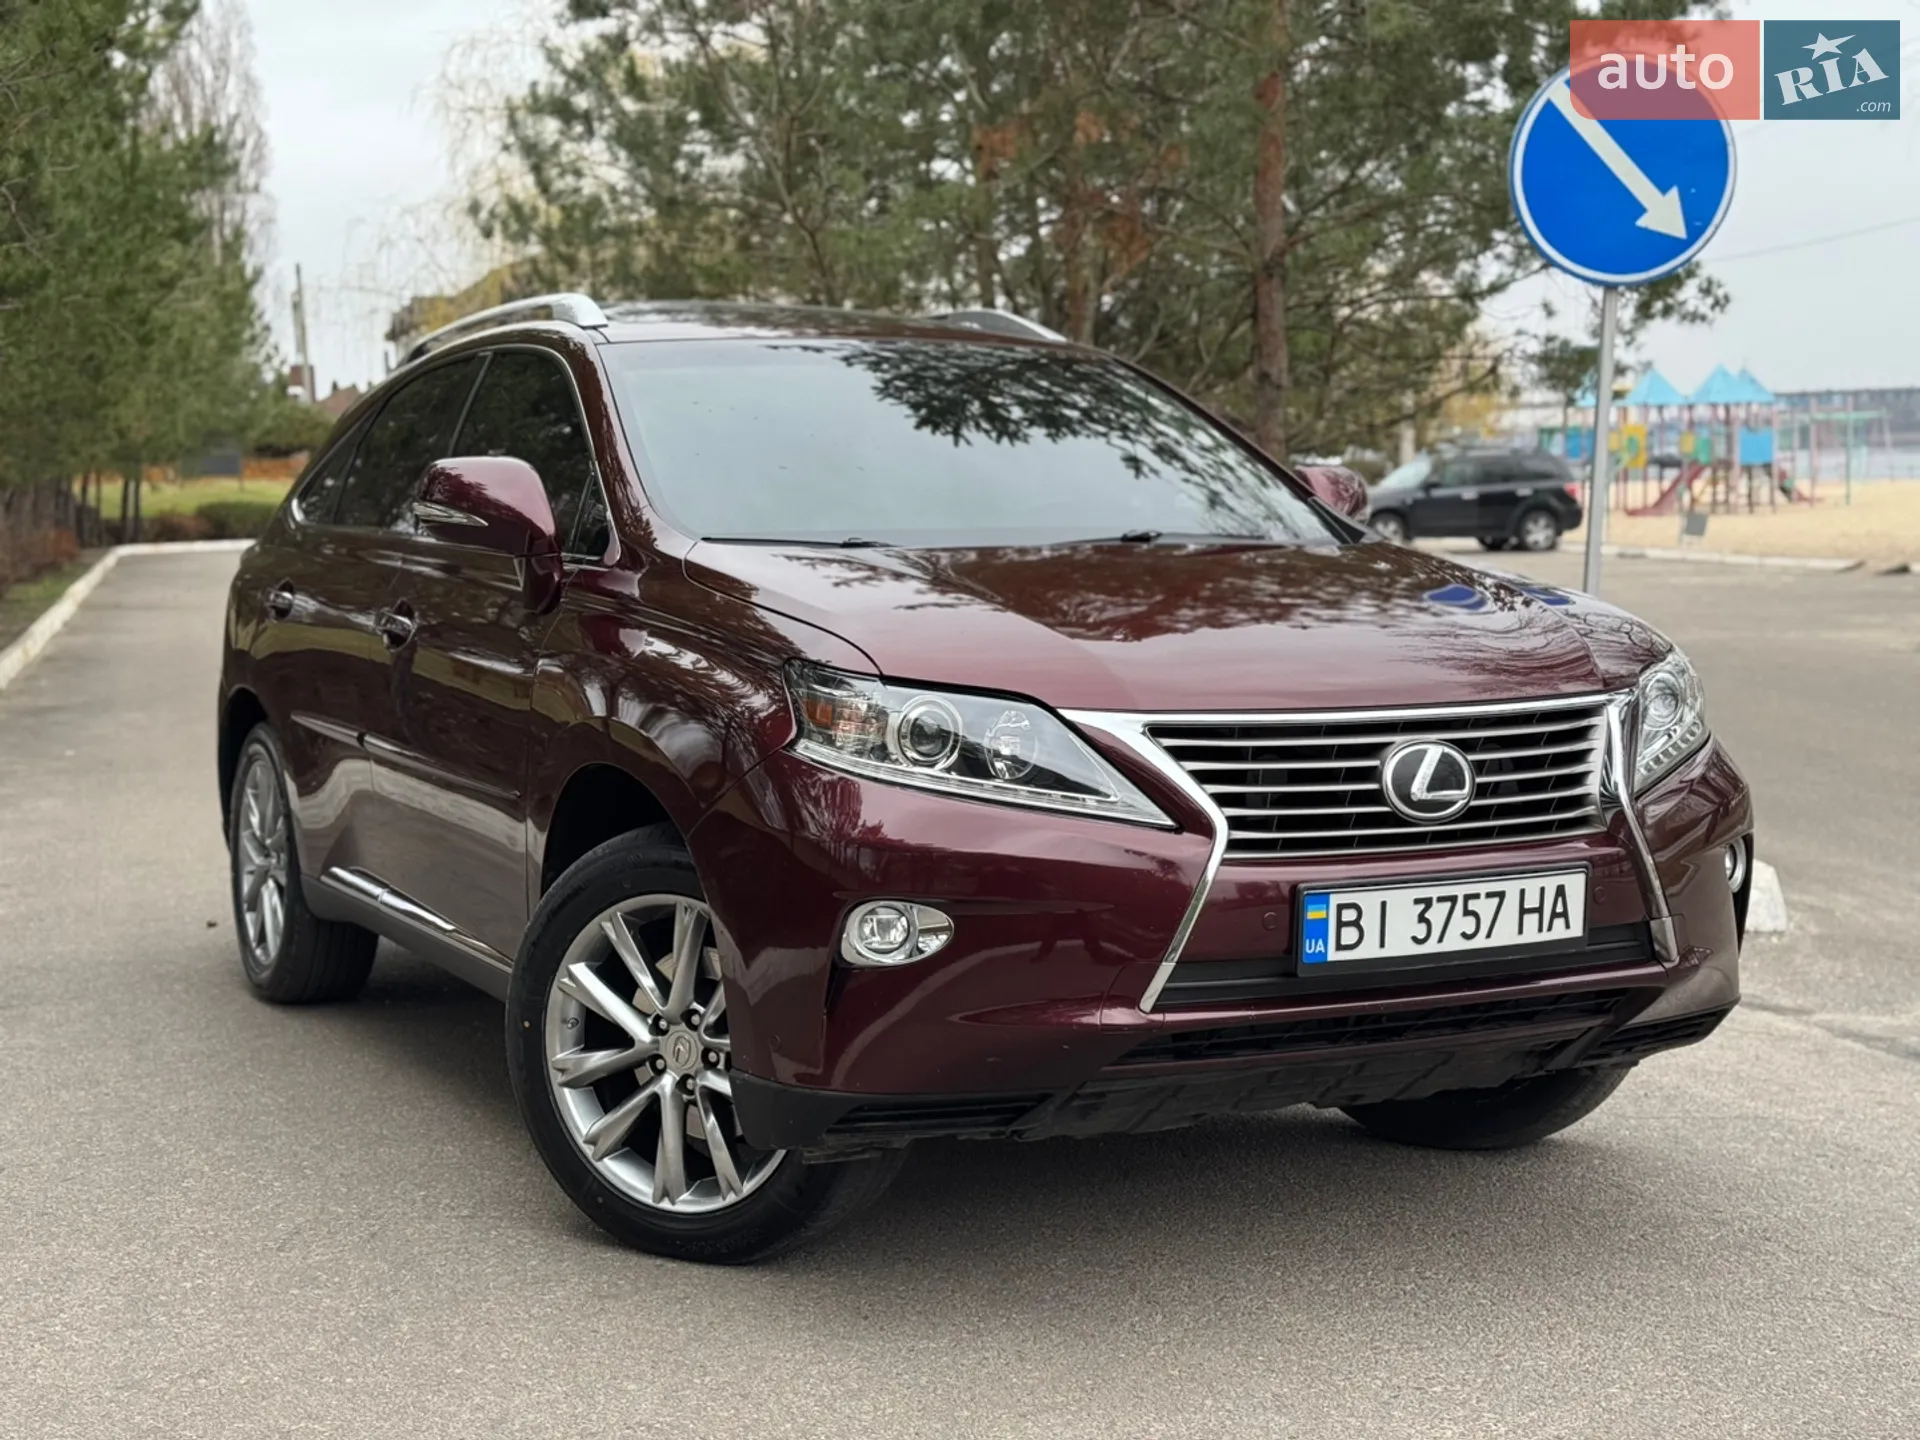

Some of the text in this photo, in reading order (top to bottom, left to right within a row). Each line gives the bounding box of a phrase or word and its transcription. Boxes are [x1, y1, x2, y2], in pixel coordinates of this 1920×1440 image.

[1410, 890, 1506, 945] 3757
[1517, 884, 1571, 935] HA
[1305, 938, 1325, 954] UA
